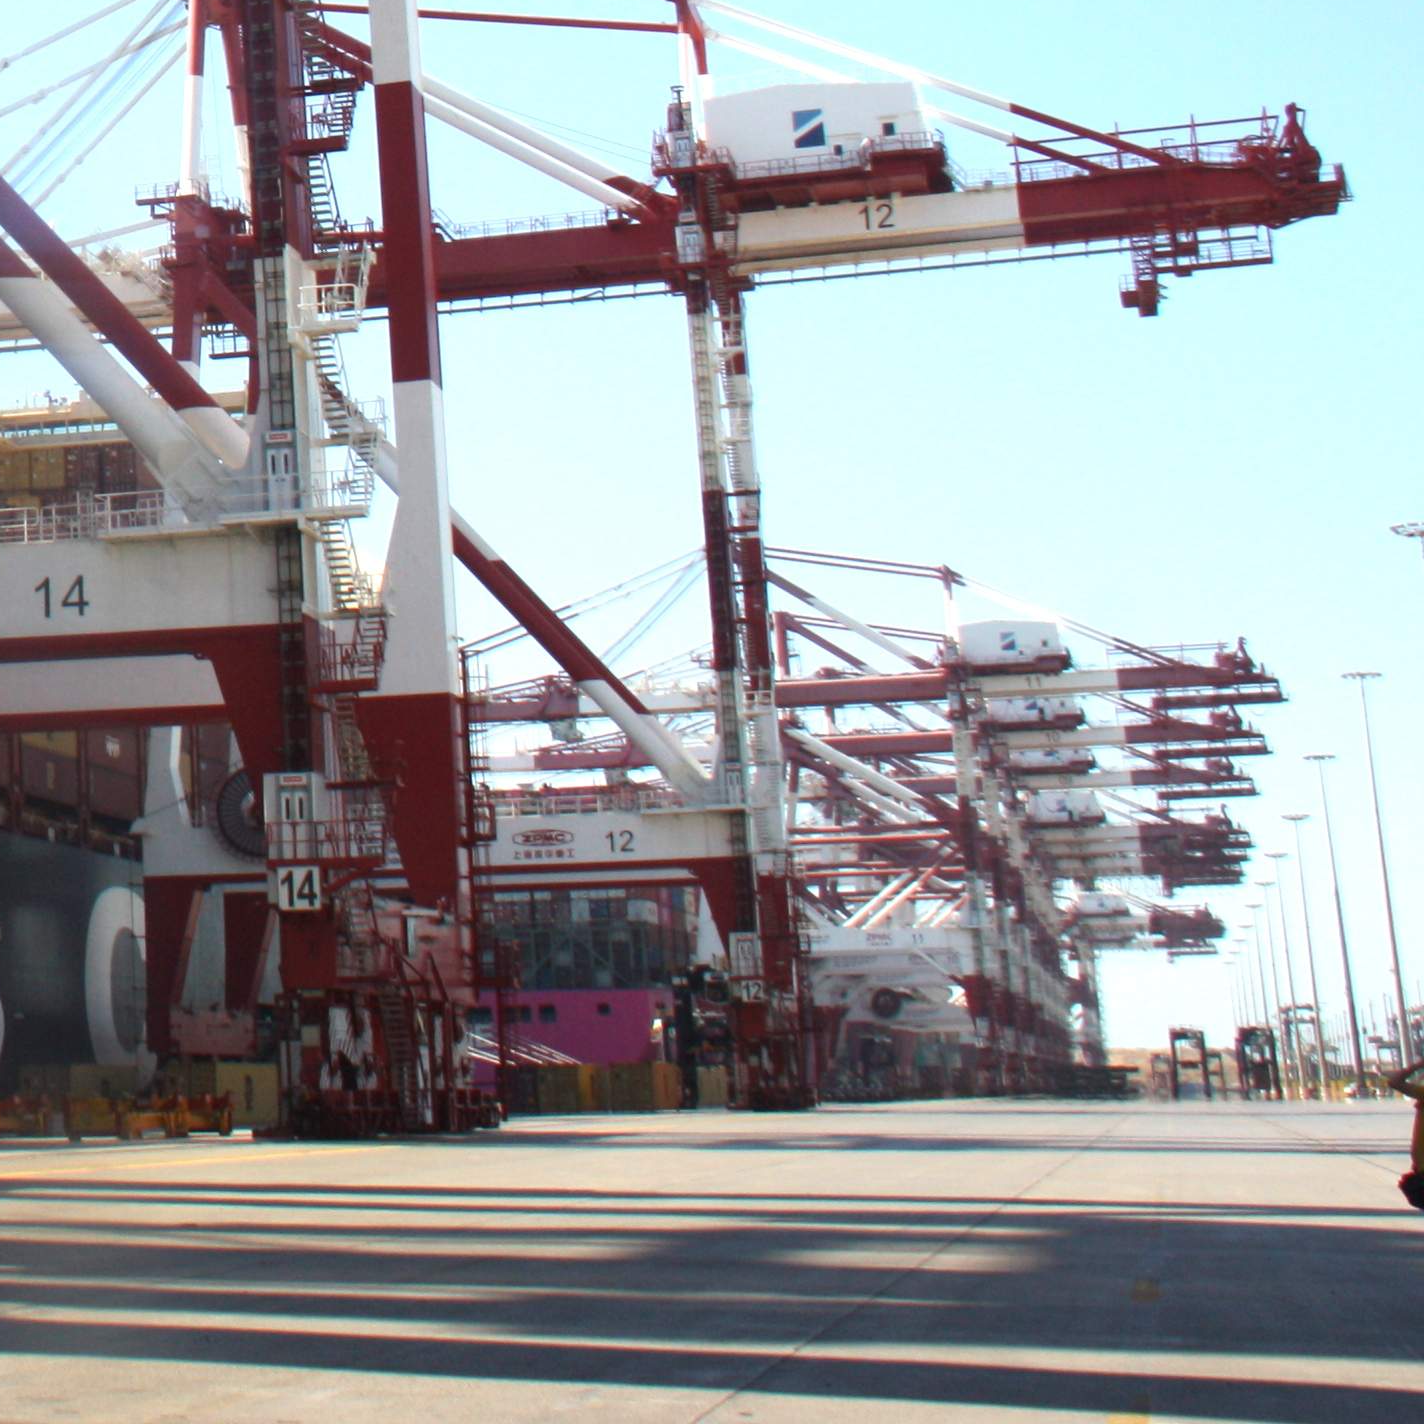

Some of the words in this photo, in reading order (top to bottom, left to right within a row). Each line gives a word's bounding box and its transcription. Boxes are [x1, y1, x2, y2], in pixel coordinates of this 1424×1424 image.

[858, 203, 895, 231] 12
[34, 574, 89, 619] 14
[604, 830, 635, 852] 12
[280, 869, 318, 907] 14
[742, 981, 762, 1001] 12
